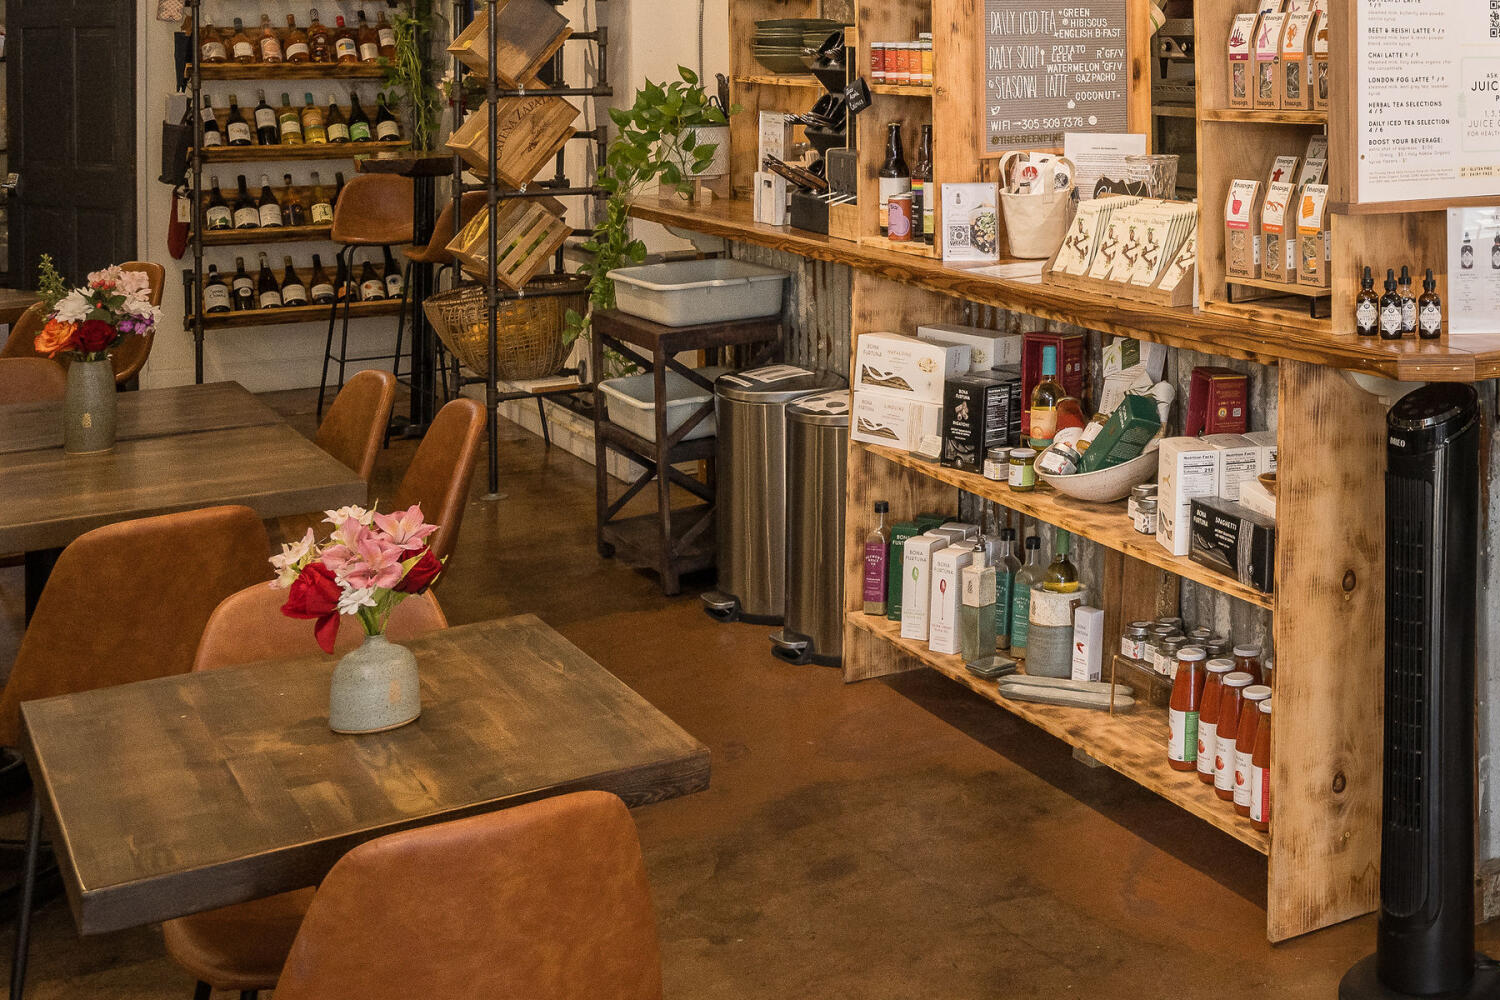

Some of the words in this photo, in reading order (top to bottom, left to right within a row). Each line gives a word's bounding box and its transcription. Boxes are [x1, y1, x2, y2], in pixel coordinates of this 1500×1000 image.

[990, 10, 1015, 36] DAILY
[1020, 10, 1038, 36] ICED
[1040, 10, 1056, 34] TEA
[1063, 8, 1090, 18] GREEN
[1070, 18, 1108, 28] HIBISCUS
[1060, 28, 1092, 38] ENGLISH
[990, 45, 1012, 70] DAILY
[1017, 46, 1040, 69] SOUP
[1052, 45, 1086, 54] POTATO
[1052, 52, 1072, 62] LEEK
[1104, 49, 1124, 58] GF/V
[1047, 63, 1100, 73] WATERMELON
[1104, 62, 1122, 71] GF/V
[1076, 72, 1116, 82] GAZPACHO
[995, 76, 1038, 100] SEASONAL
[1046, 74, 1068, 98] LATTE
[1075, 91, 1116, 100] COCONUT
[990, 120, 1010, 131] WIFI
[1022, 119, 1040, 129] 305
[1042, 118, 1060, 128] 509
[1063, 117, 1084, 128] 7378
[1468, 119, 1493, 128] JUICE
[1196, 509, 1207, 518] BONA
[1194, 516, 1208, 527] FURTUNA
[1214, 516, 1237, 531] SPAGHETTI
[905, 555, 927, 563] FURTUNA
